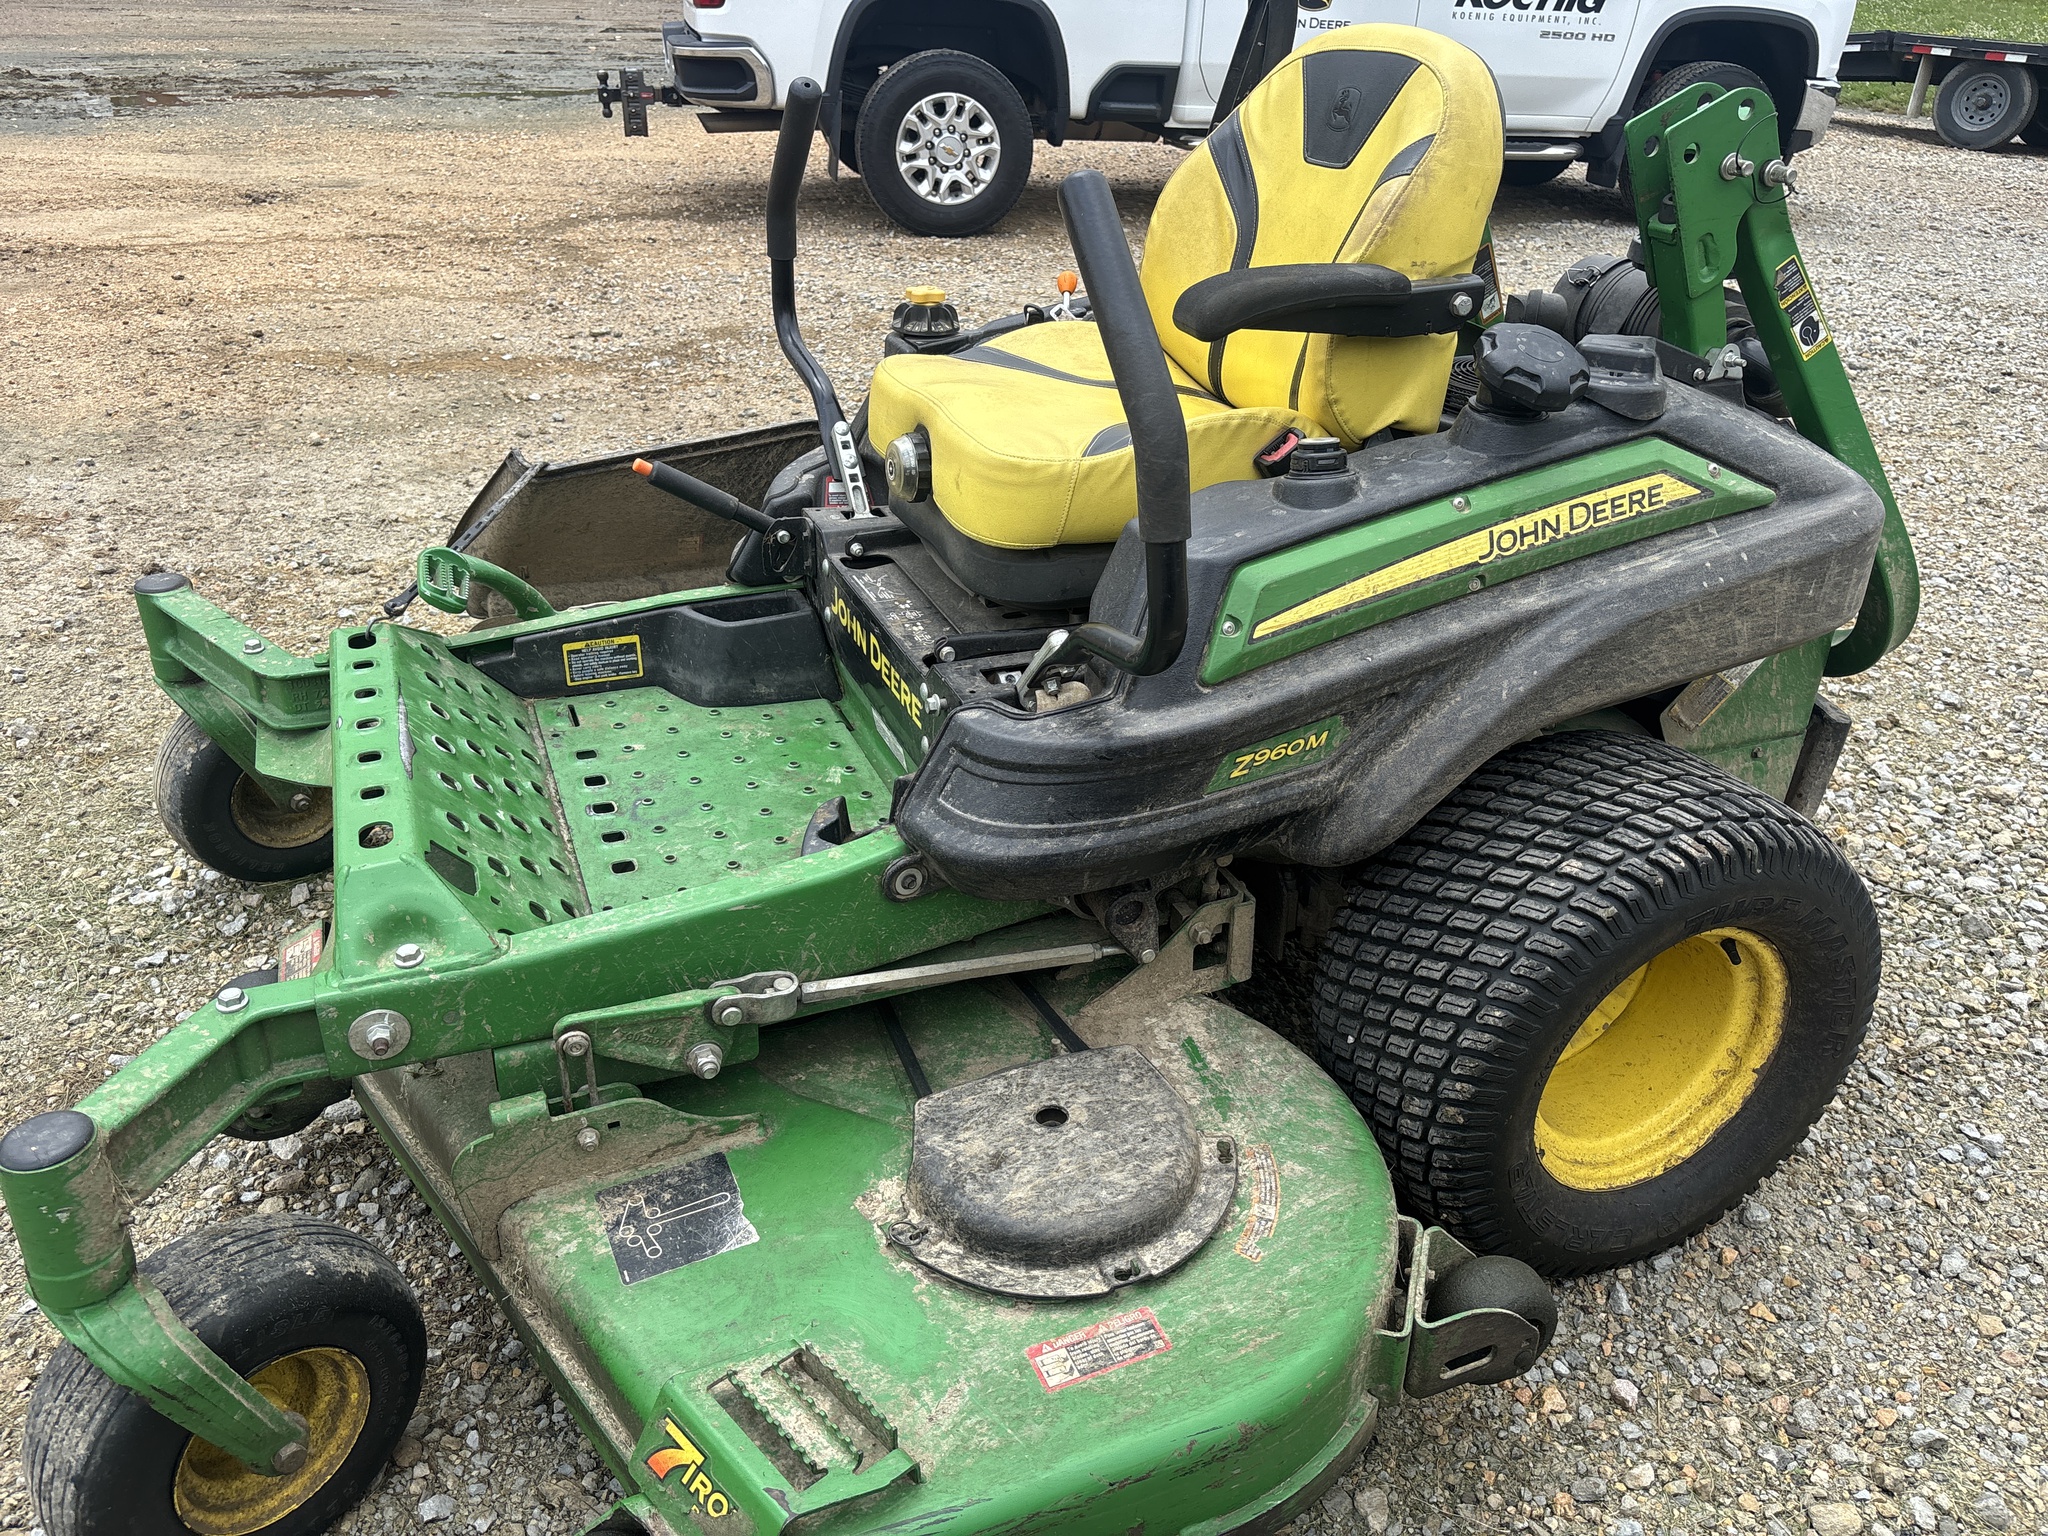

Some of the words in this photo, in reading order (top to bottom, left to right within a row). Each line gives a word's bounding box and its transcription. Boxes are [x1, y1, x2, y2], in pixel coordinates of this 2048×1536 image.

[1452, 11, 1495, 21] KOENIG
[1502, 13, 1571, 26] EQUIPMENT,
[1578, 16, 1602, 26] INC.
[1539, 30, 1586, 40] 2500
[1591, 33, 1616, 42] HD
[1805, 340, 1825, 358] CAUTION
[1479, 514, 1561, 561] JOHN
[1569, 483, 1663, 531] DEERE
[590, 639, 615, 647] CAUTION
[831, 586, 867, 655] JOHN
[870, 632, 923, 730] DEERE
[1229, 730, 1329, 779] Z960M
[1685, 895, 1802, 934] TURF
[1794, 906, 1857, 1060] MASTER
[1108, 1311, 1142, 1330] PELIGRO
[1051, 1331, 1086, 1349] DANGER
